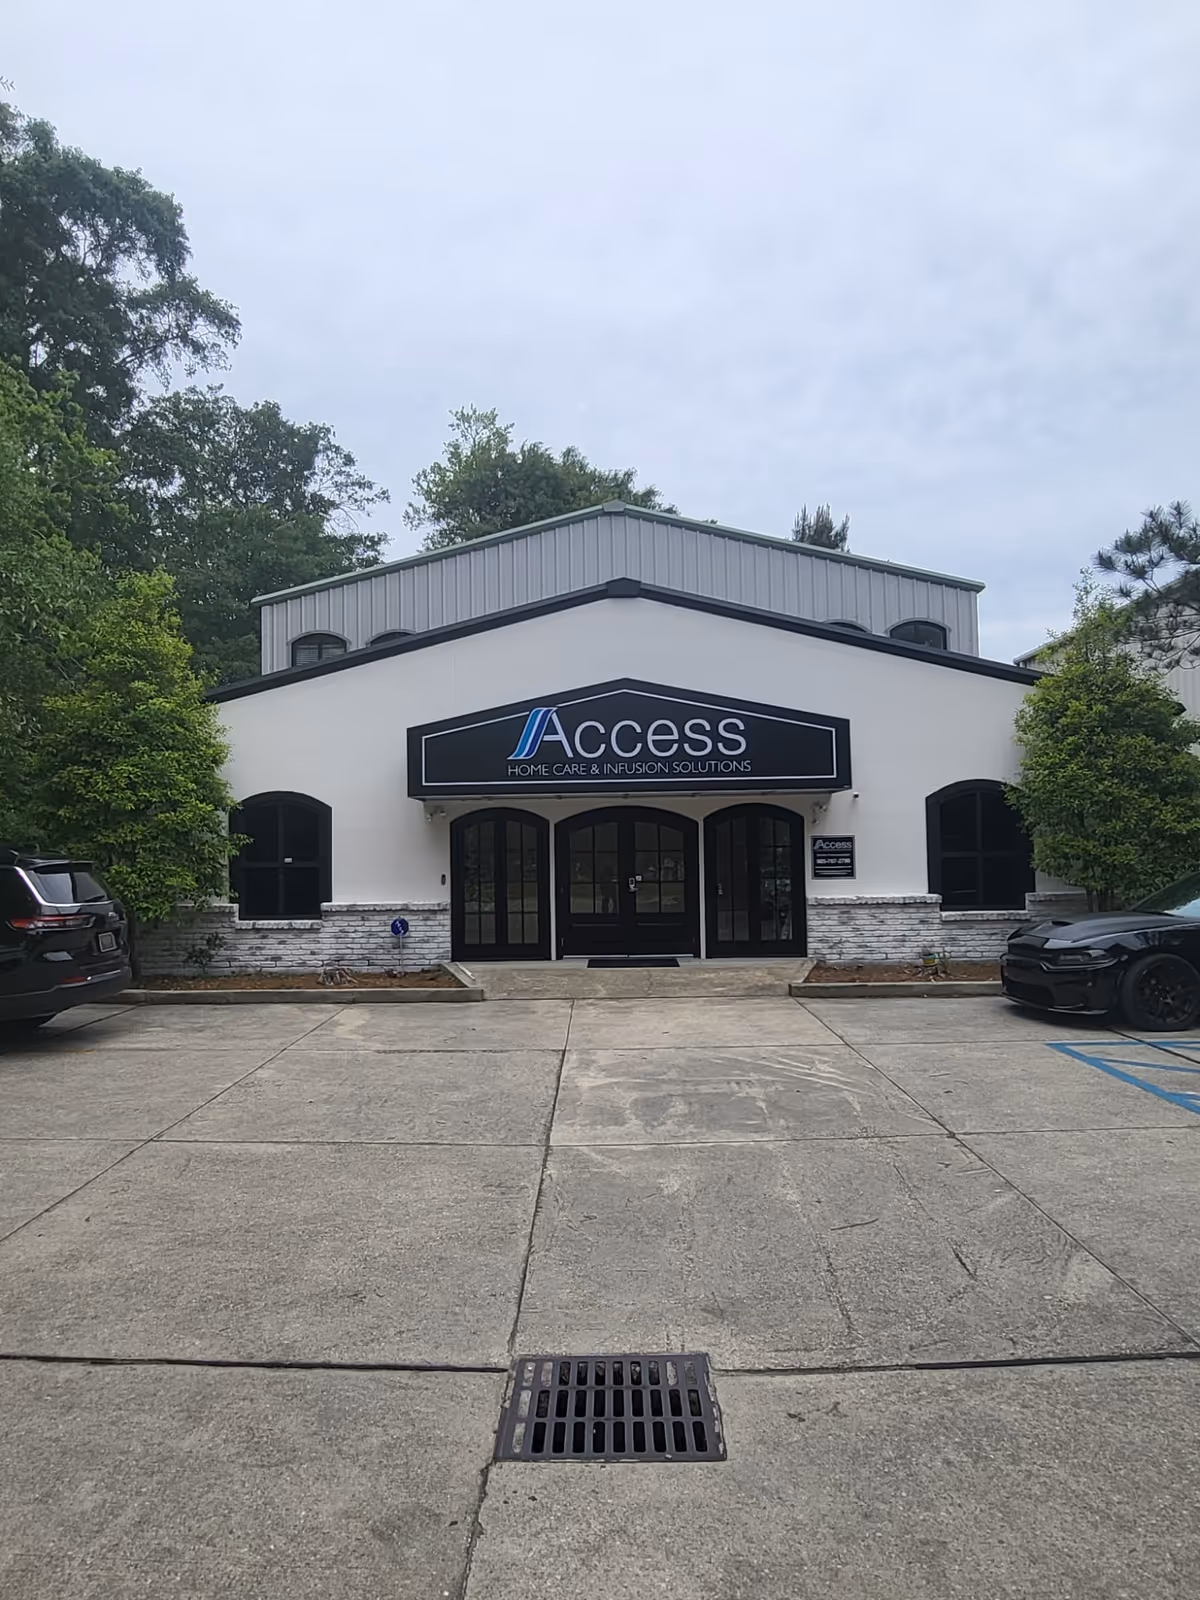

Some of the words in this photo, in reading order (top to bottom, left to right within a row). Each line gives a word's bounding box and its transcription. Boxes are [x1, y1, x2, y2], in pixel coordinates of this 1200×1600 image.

[508, 764, 549, 777] HOME
[553, 763, 587, 776] CARE
[590, 763, 600, 775] &
[603, 762, 669, 775] INFUSION
[672, 760, 752, 774] SOLUTIONS
